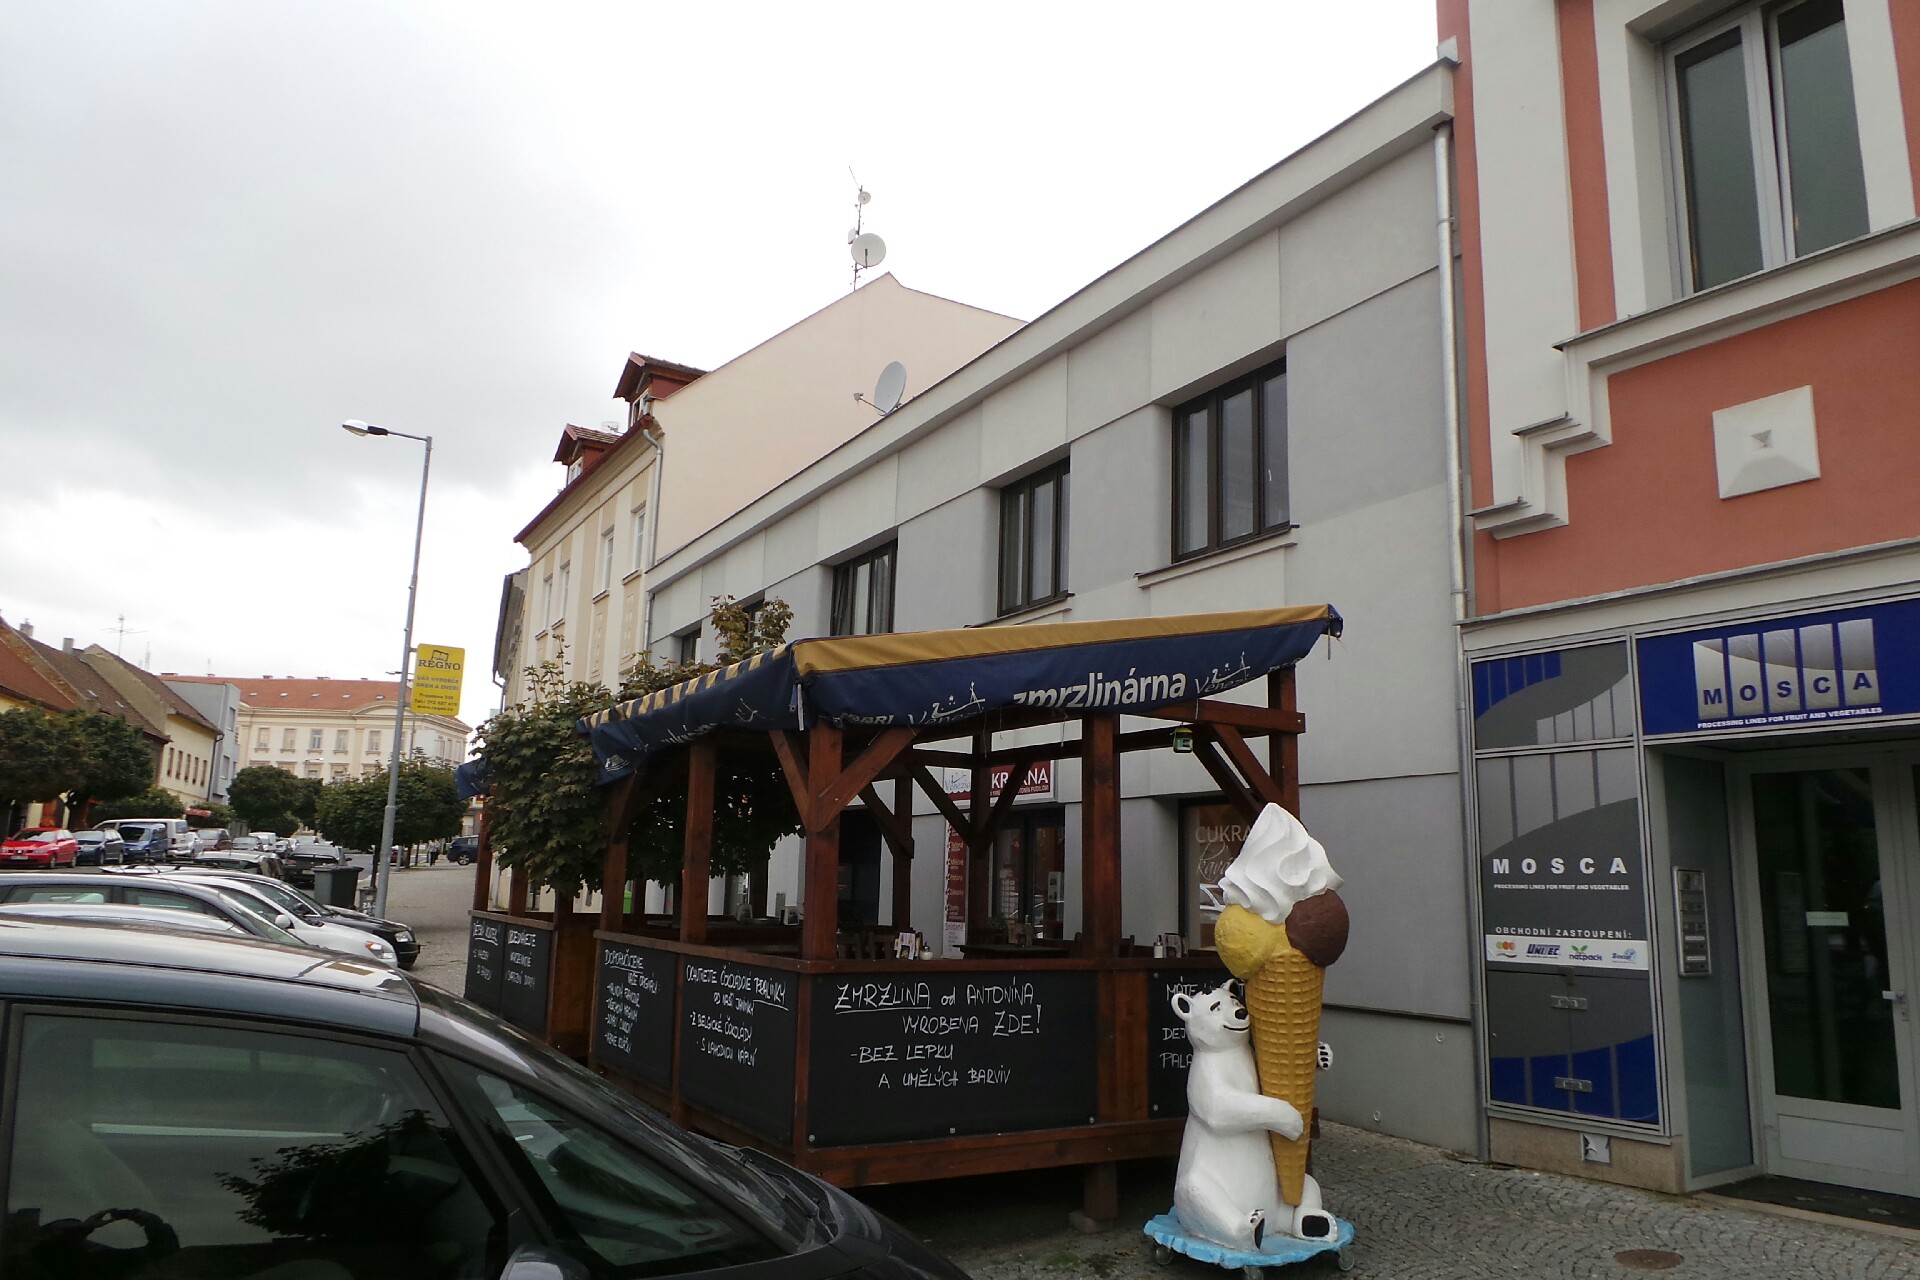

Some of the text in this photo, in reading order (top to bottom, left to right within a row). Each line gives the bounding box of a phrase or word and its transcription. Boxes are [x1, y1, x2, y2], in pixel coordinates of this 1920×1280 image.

[418, 659, 461, 671] REGNO
[1012, 667, 1187, 708] zmrzlinárna
[1703, 672, 1873, 706] MOSCA
[1697, 706, 1883, 729] PROCESSING LINES FOR FRUIT AND VEGETABLES
[1492, 857, 1628, 875] MOSCA
[1495, 926, 1633, 939] OBCHODNÍ ZASTOUPENÍ:
[835, 983, 932, 1011] ZMRZLINA
[940, 987, 957, 1006] od
[992, 1004, 1042, 1037] ZDE!
[1162, 1027, 1186, 1041] DEJ
[905, 1043, 954, 1061] LEPKU
[1160, 1052, 1193, 1069] PALA
[878, 1073, 891, 1089] A
[902, 1065, 960, 1088] UMĚLÝCH
